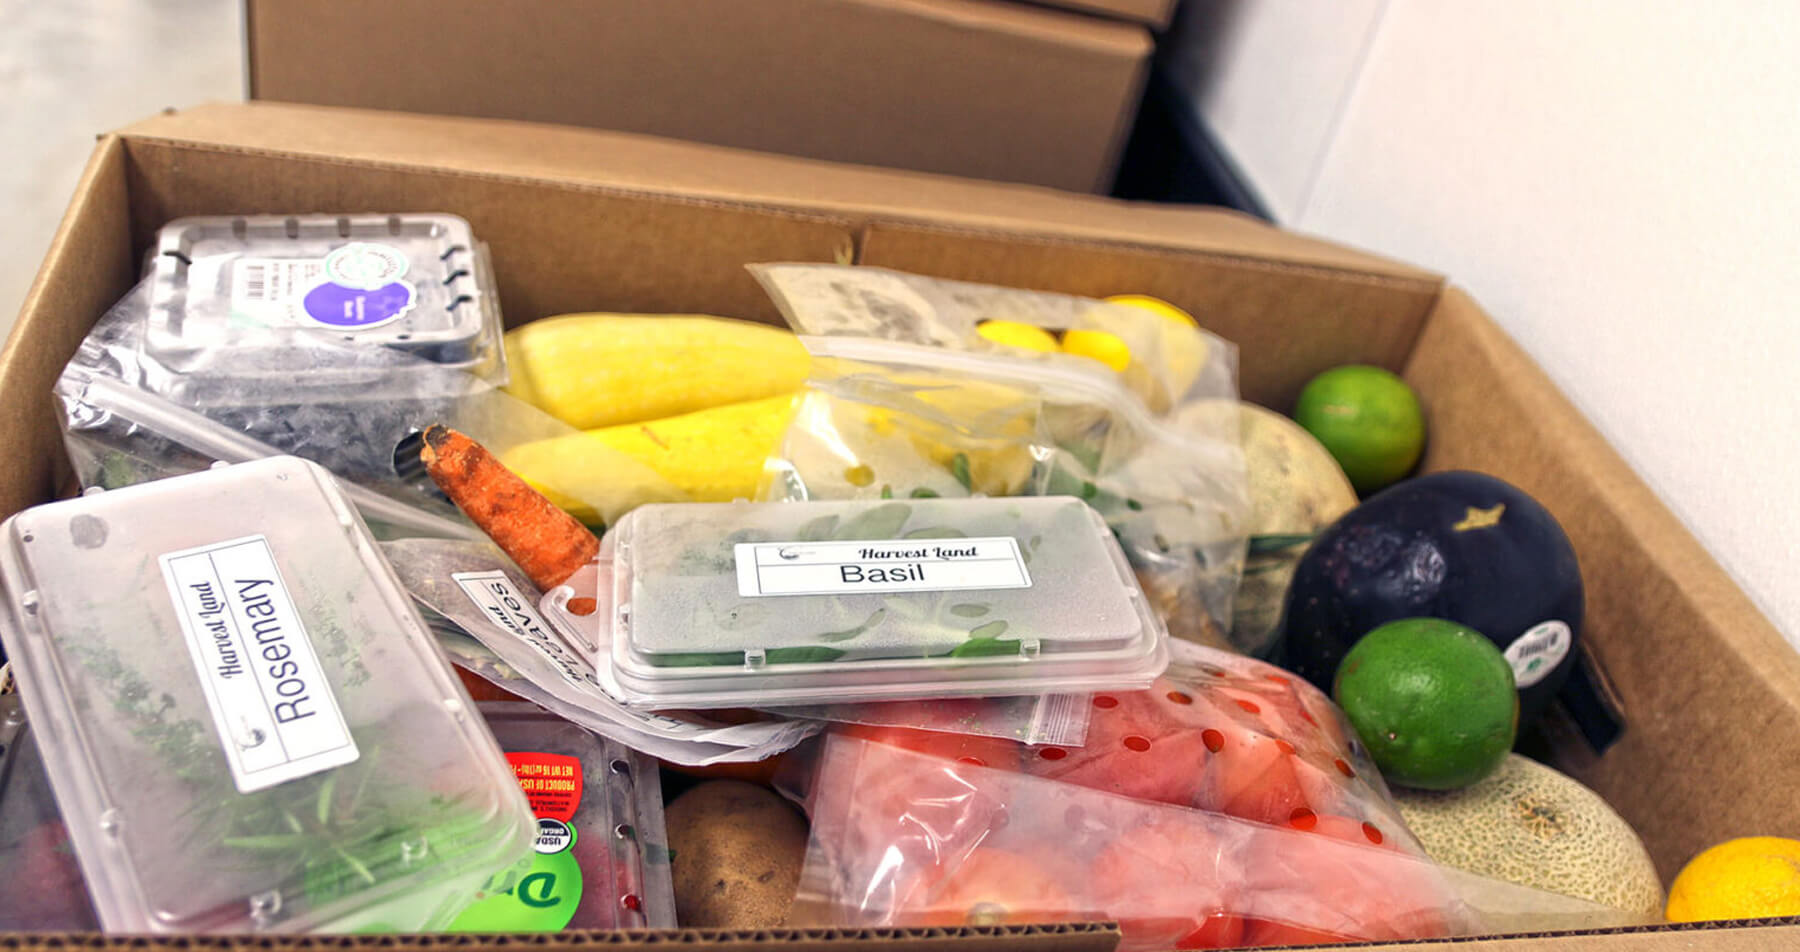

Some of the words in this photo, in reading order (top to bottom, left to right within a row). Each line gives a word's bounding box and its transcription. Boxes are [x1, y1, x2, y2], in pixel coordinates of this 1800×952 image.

[858, 547, 928, 559] Harvest
[932, 546, 978, 560] Land
[840, 563, 926, 583] Basil
[189, 581, 226, 619] Land
[490, 582, 579, 666] Leaves
[204, 619, 244, 679] Harvest
[234, 578, 316, 724] Rosemary
[535, 778, 544, 791] OF
[545, 778, 575, 791] PRODUCT
[561, 765, 573, 776] NET
[476, 872, 561, 908] Dri
